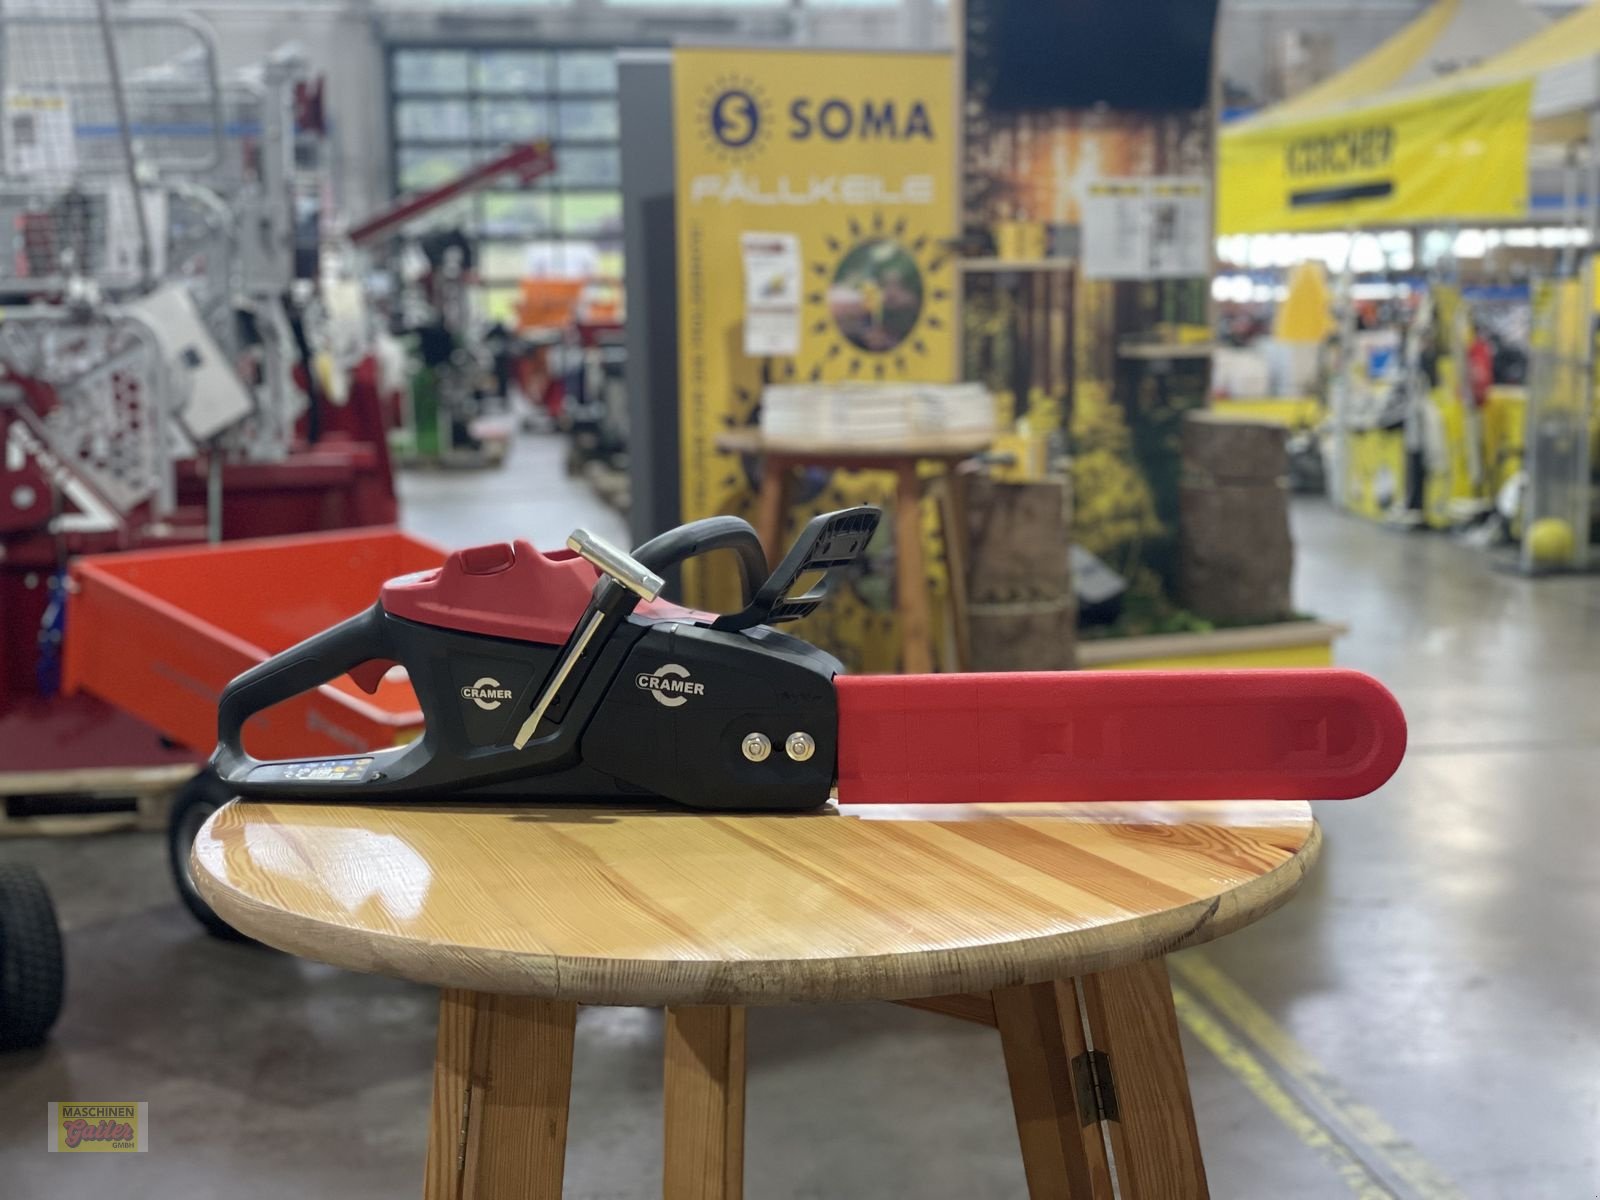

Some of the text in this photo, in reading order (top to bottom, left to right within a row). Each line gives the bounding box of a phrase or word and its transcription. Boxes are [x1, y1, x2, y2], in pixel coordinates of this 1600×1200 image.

[790, 98, 934, 141] SOMA
[463, 687, 513, 699] CRAMER
[636, 675, 705, 695] CRAMER
